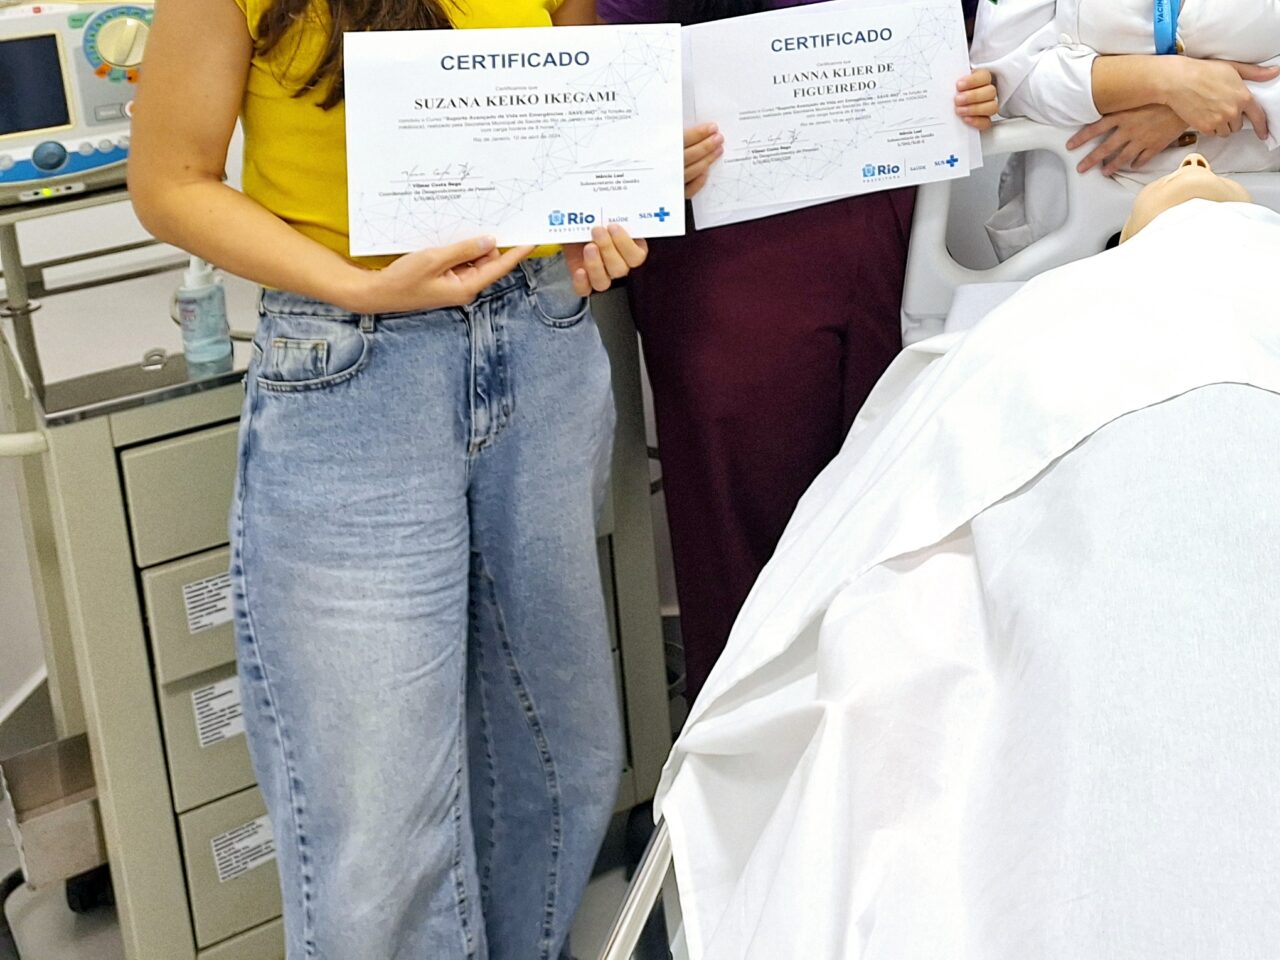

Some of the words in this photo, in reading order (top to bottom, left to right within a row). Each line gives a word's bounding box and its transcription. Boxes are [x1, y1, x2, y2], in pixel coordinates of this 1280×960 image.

[771, 28, 892, 52] CERTIFICADO
[440, 50, 590, 70] CERTIFICADO
[773, 71, 828, 84] LUANNA
[833, 65, 873, 77] KLIER
[877, 62, 894, 72] DE
[793, 80, 876, 98] FIGUEIREDO
[414, 97, 480, 108] SUZANA
[486, 95, 538, 106] KEIKO
[544, 91, 615, 103] IKEGAMI
[878, 164, 900, 176] Rio
[567, 212, 596, 224] Rio
